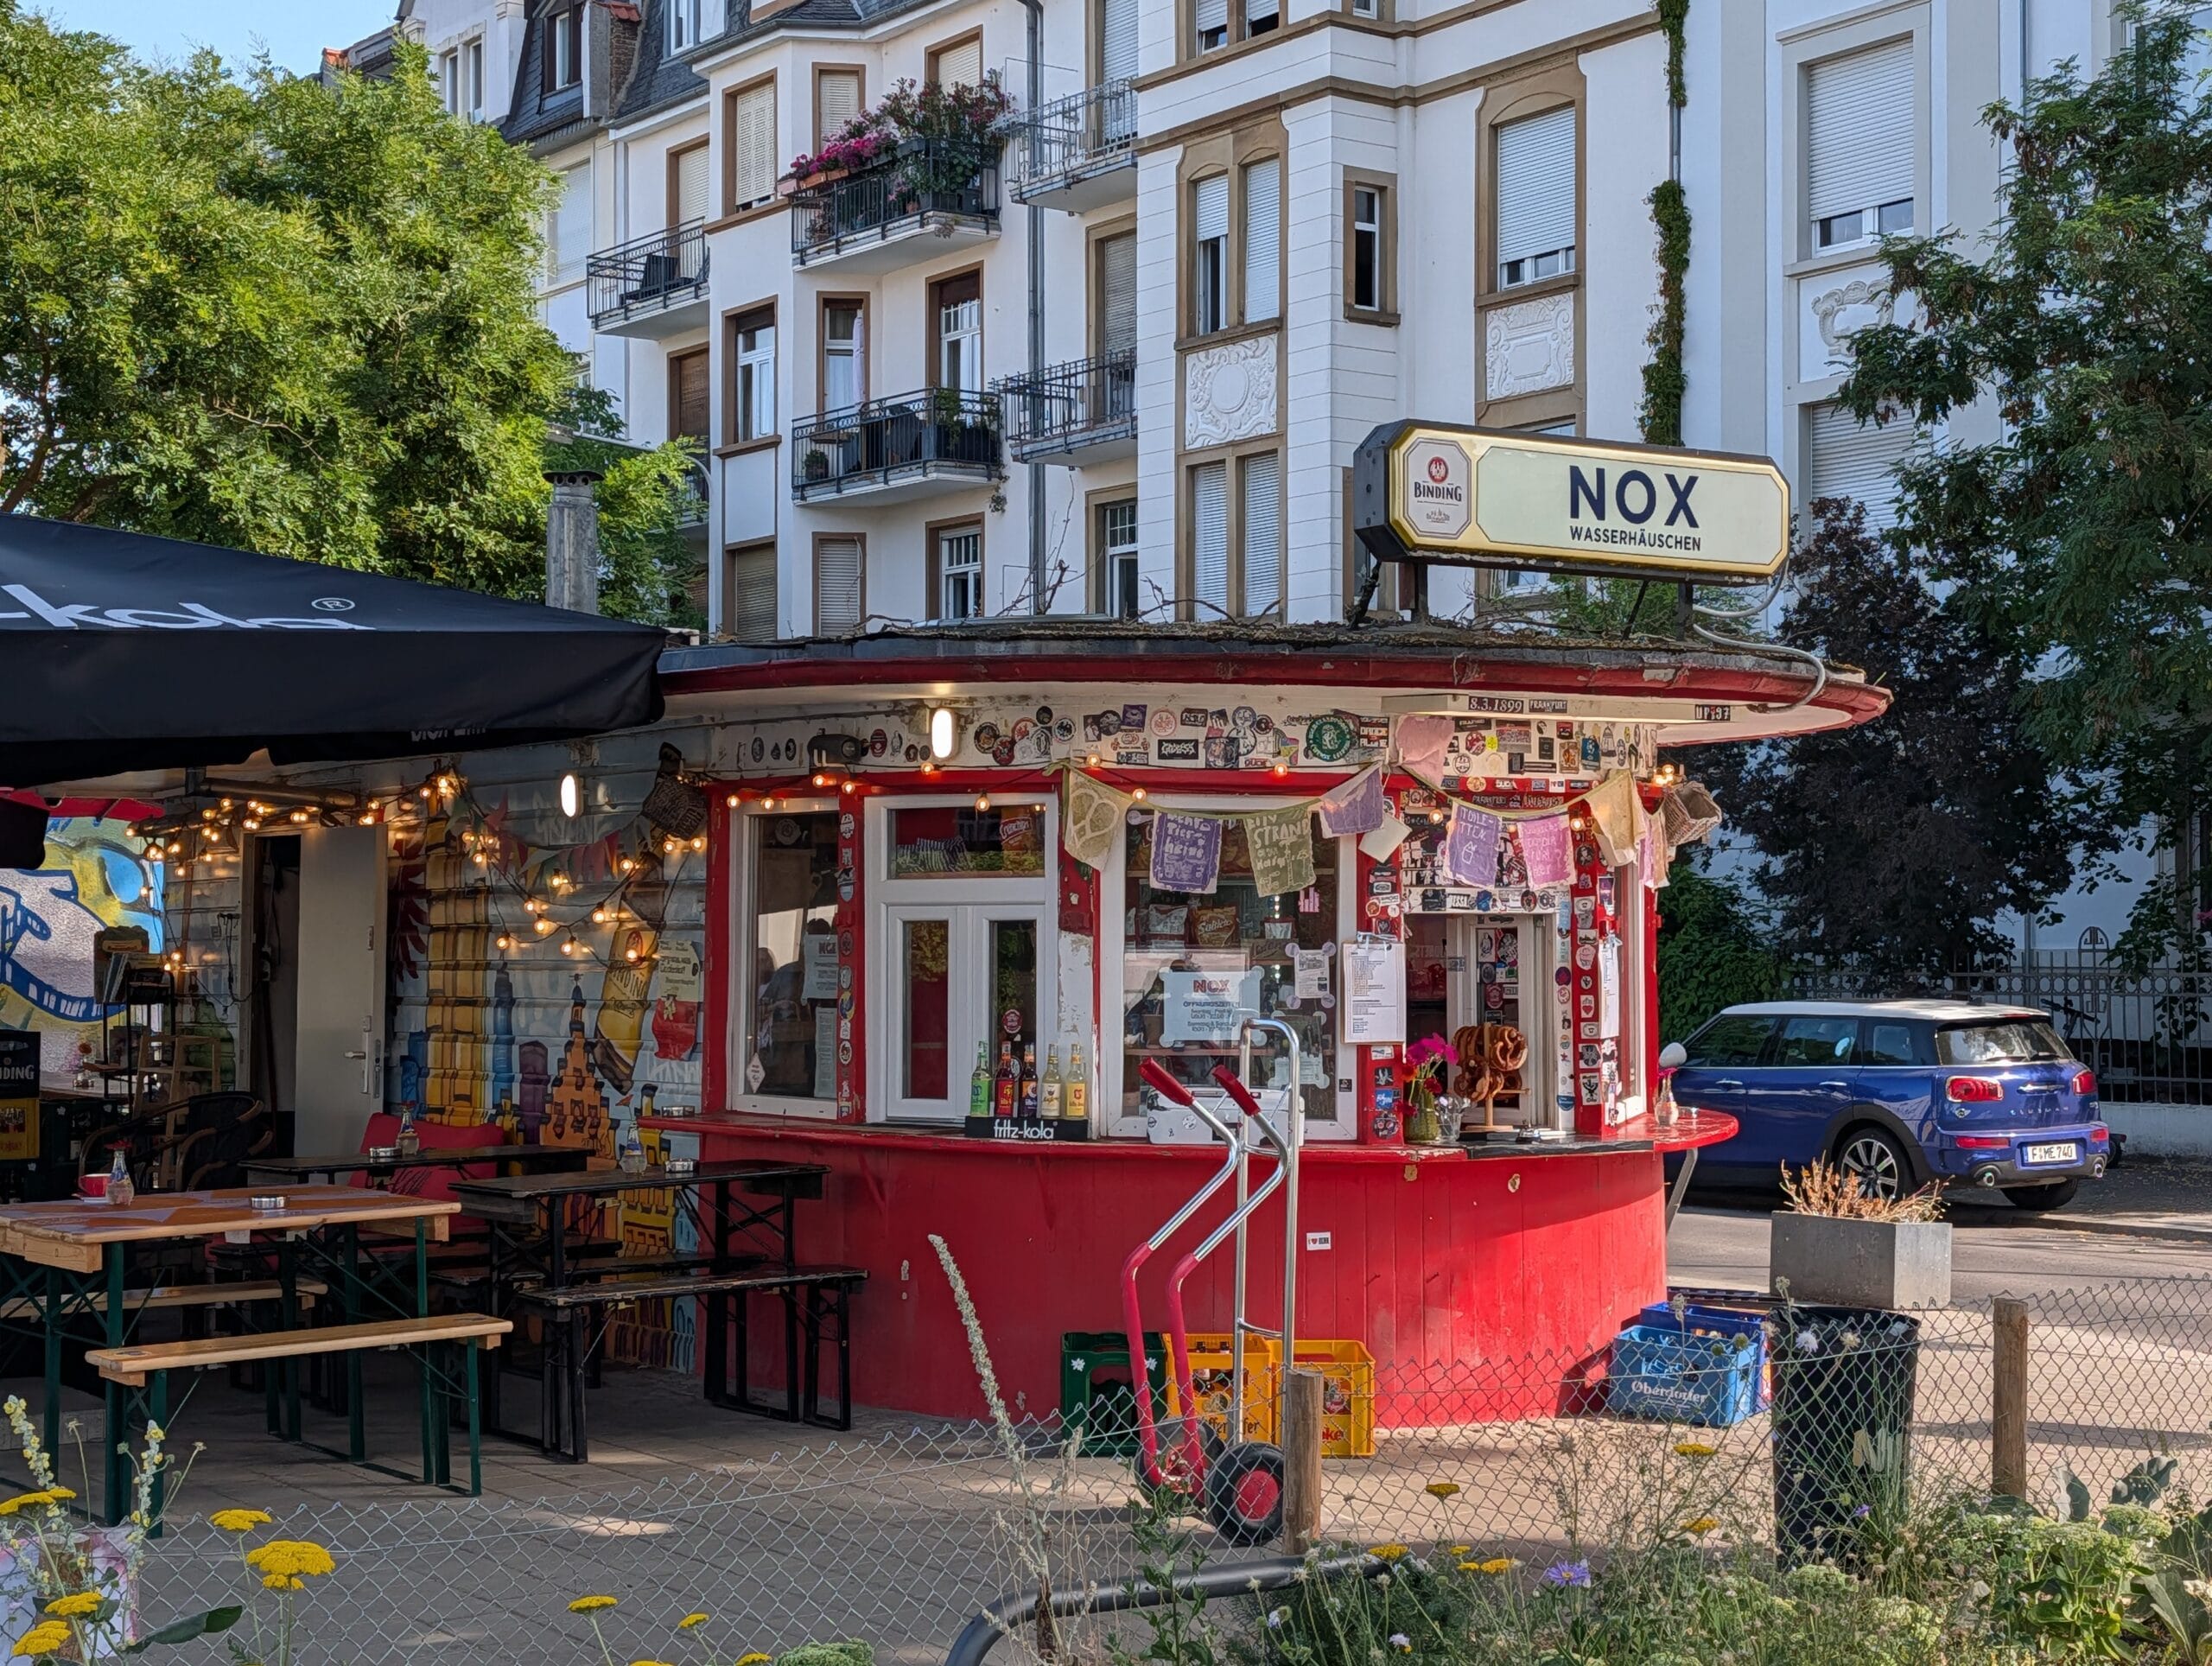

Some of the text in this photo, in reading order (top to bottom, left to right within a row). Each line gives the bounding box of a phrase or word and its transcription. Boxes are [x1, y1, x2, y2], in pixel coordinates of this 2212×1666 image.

[1414, 481, 1462, 501] BINDING
[1569, 465, 1700, 528] NOX
[1569, 525, 1700, 551] WASSERHÄUSCHEN
[1470, 697, 1522, 713] 8.3.1899
[1253, 818, 1309, 849] STRAND
[1193, 979, 1230, 993] NOX
[994, 1119, 1054, 1139] fritz-kola
[2056, 1145, 2073, 1159] 740
